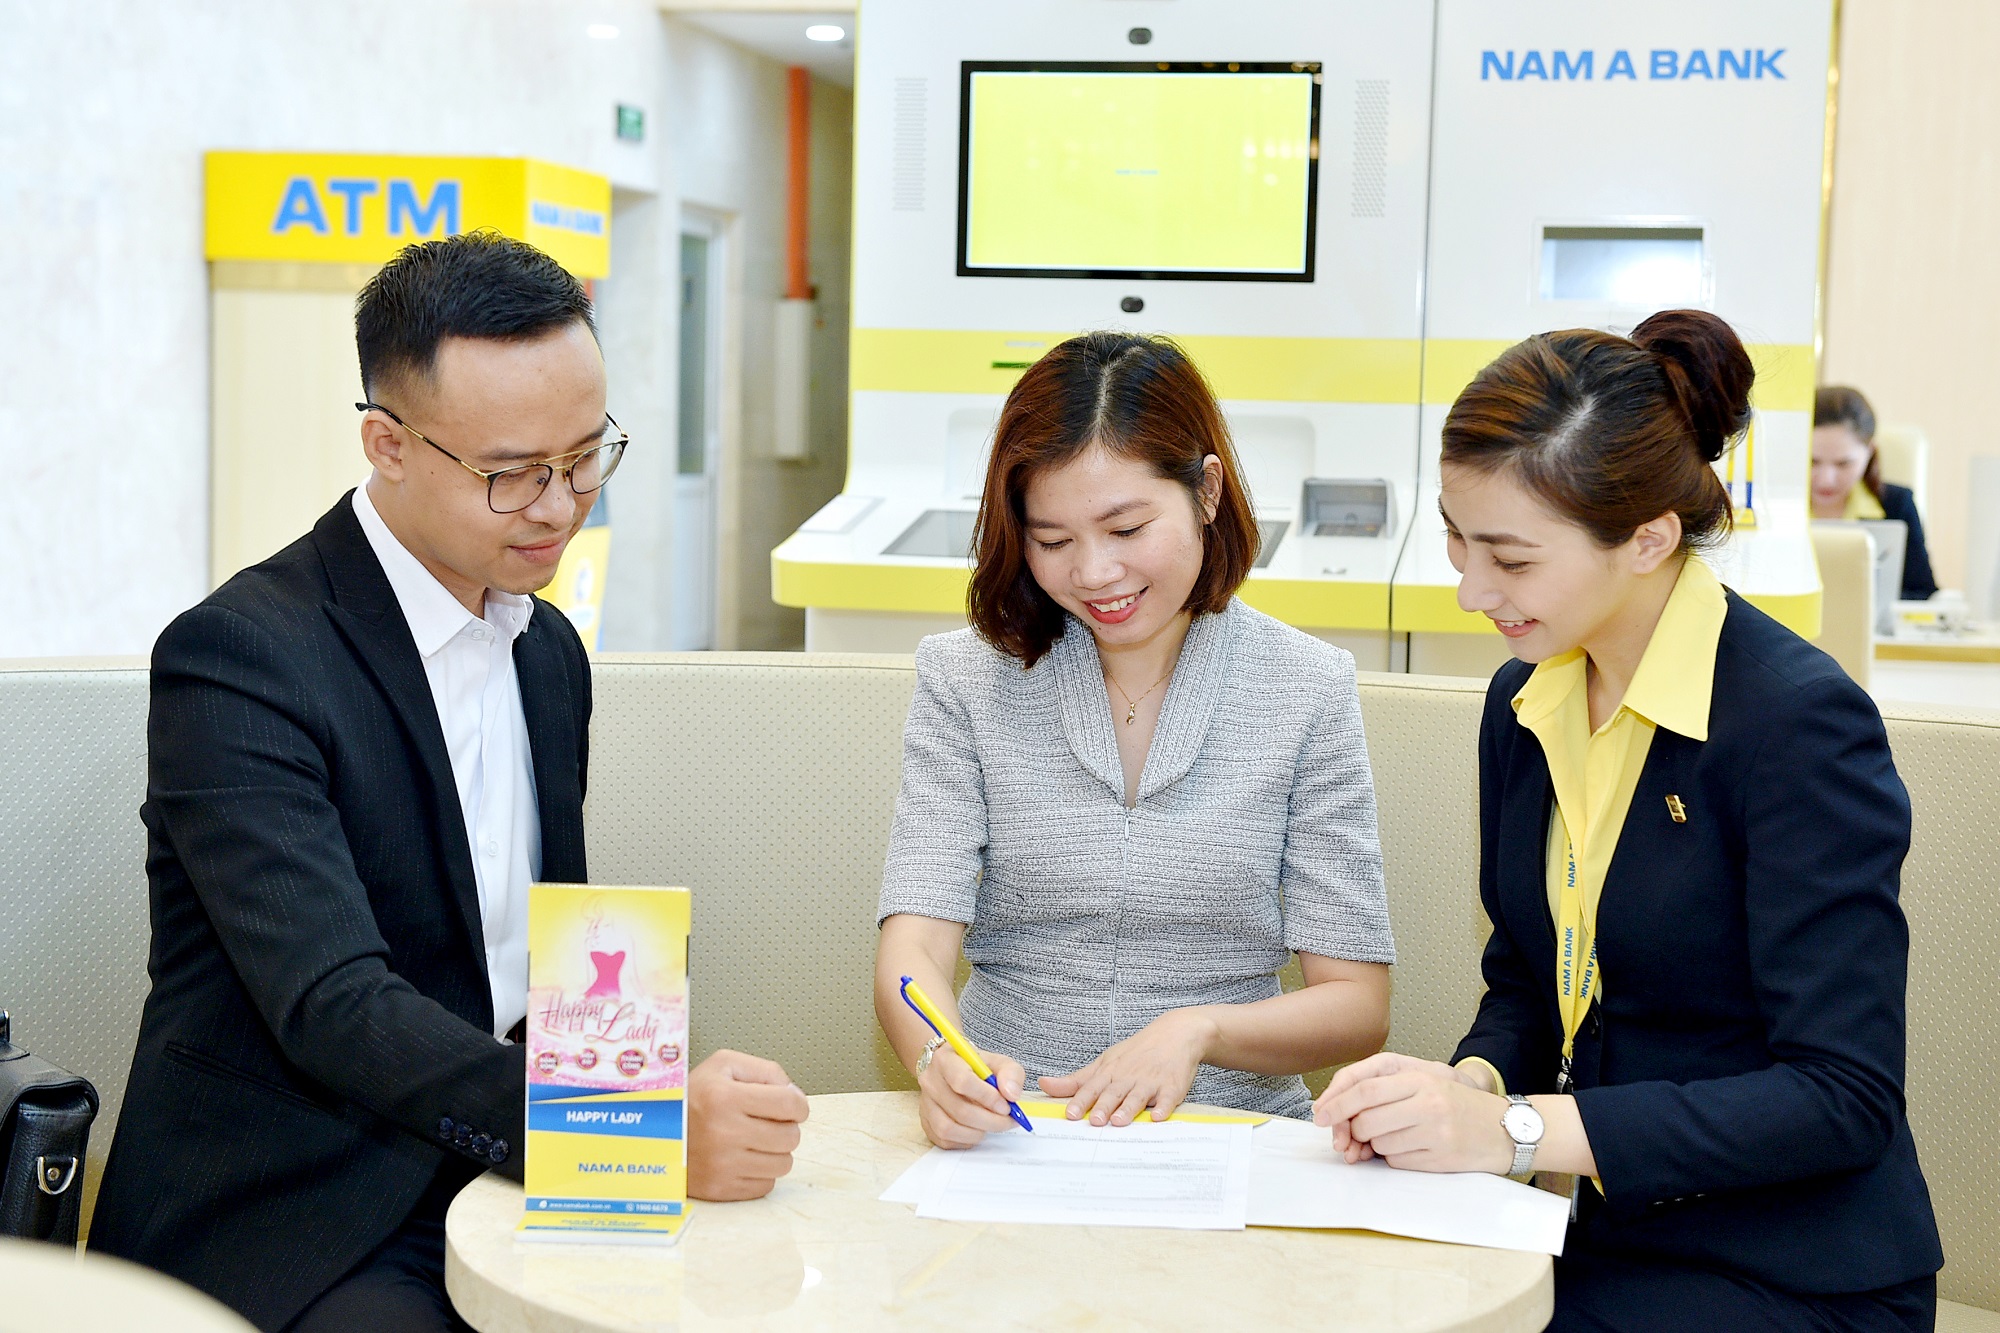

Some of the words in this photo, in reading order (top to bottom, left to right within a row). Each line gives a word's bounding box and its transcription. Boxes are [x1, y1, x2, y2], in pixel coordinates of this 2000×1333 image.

[1481, 49, 1594, 80] NAM
[1604, 49, 1637, 80] A
[1649, 48, 1787, 80] BANK
[272, 176, 461, 236] ATM
[1567, 861, 1576, 888] NAM
[1564, 926, 1573, 957] BANK
[1563, 960, 1572, 968] A
[1587, 960, 1595, 968] A
[1563, 969, 1571, 996] NAM
[1579, 969, 1593, 999] BANK
[539, 990, 605, 1032] Happy
[583, 1002, 660, 1053] Lady
[566, 1110, 609, 1123] HAPPY
[610, 1112, 643, 1124] LADY
[578, 1162, 613, 1173] NAM
[615, 1163, 625, 1173] A
[627, 1164, 667, 1175] BANK
